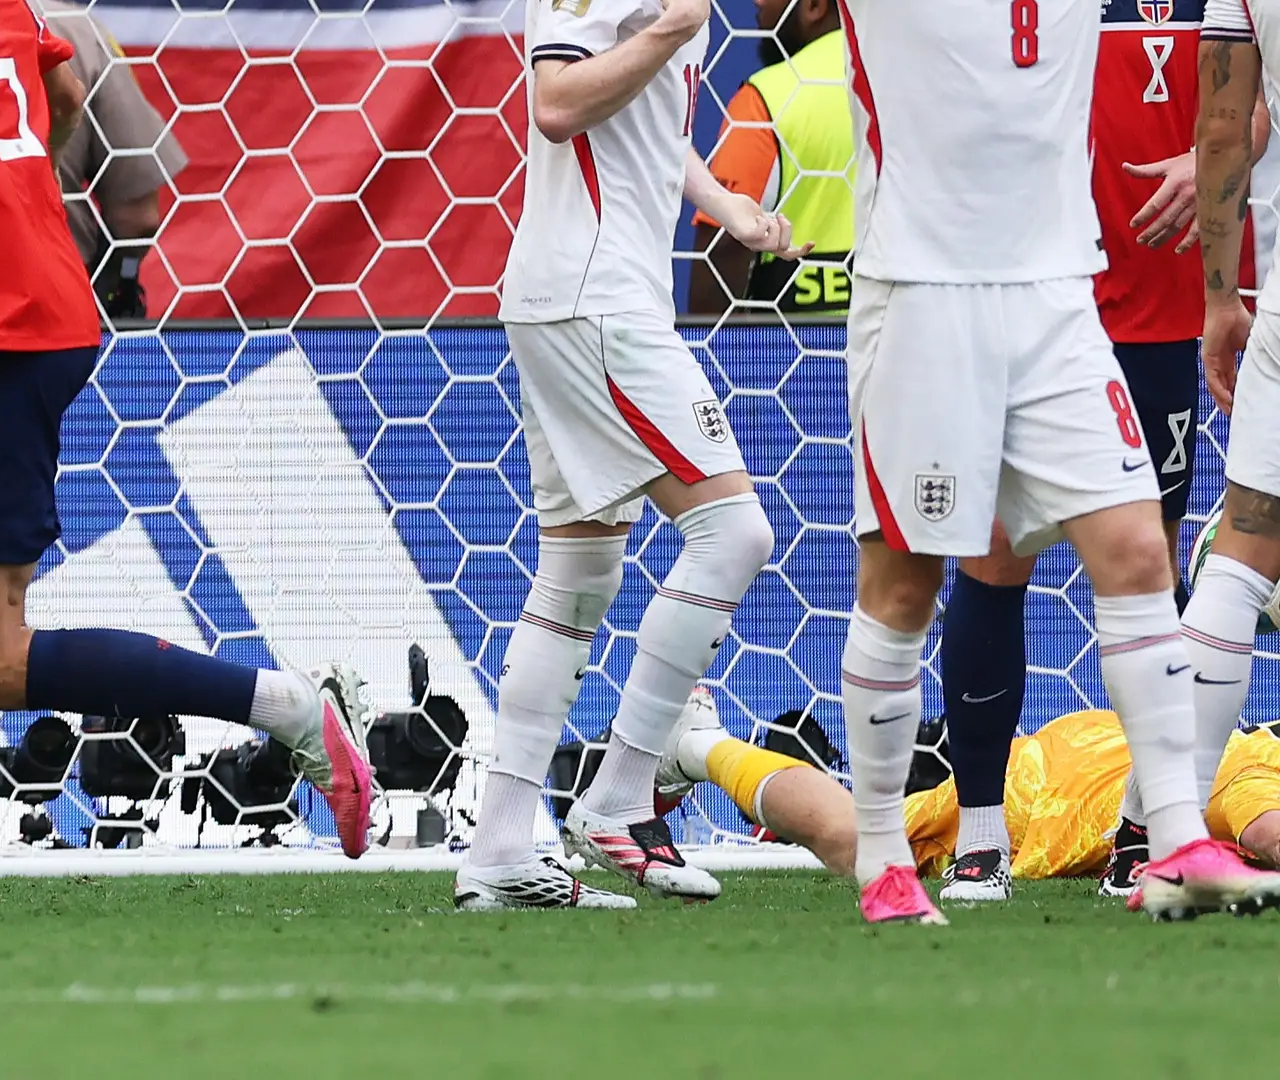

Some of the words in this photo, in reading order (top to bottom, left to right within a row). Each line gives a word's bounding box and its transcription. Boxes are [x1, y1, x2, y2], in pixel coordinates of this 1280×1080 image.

[1142, 36, 1174, 103] 8
[794, 266, 849, 305] SE
[1106, 380, 1142, 450] 8
[1161, 408, 1192, 474] 8
